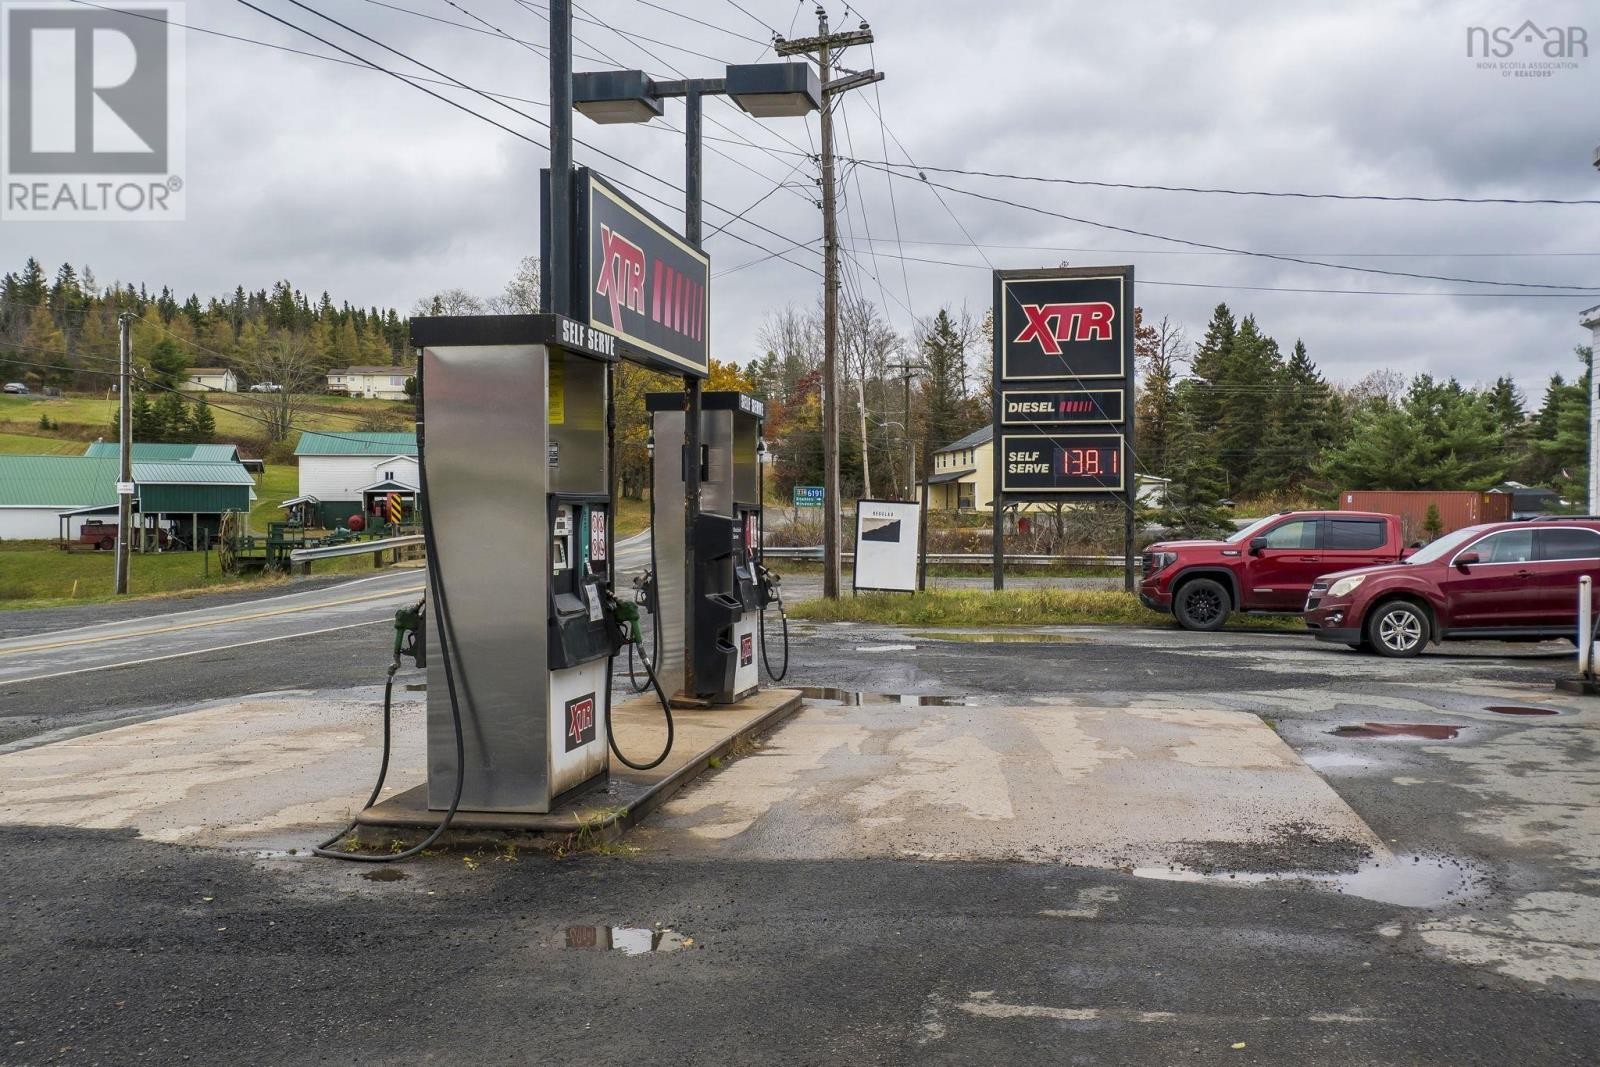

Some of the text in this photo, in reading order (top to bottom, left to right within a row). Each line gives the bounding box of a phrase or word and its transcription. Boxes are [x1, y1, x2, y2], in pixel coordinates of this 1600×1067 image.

[596, 222, 646, 333] XTR
[562, 319, 615, 357] SELF SERVE
[1013, 302, 1115, 355] XTR
[1008, 402, 1055, 413] DIESEL
[1008, 451, 1039, 462] SELF
[1008, 463, 1049, 474] SERVE
[807, 489, 822, 497] 6191
[568, 697, 593, 744] XTR
